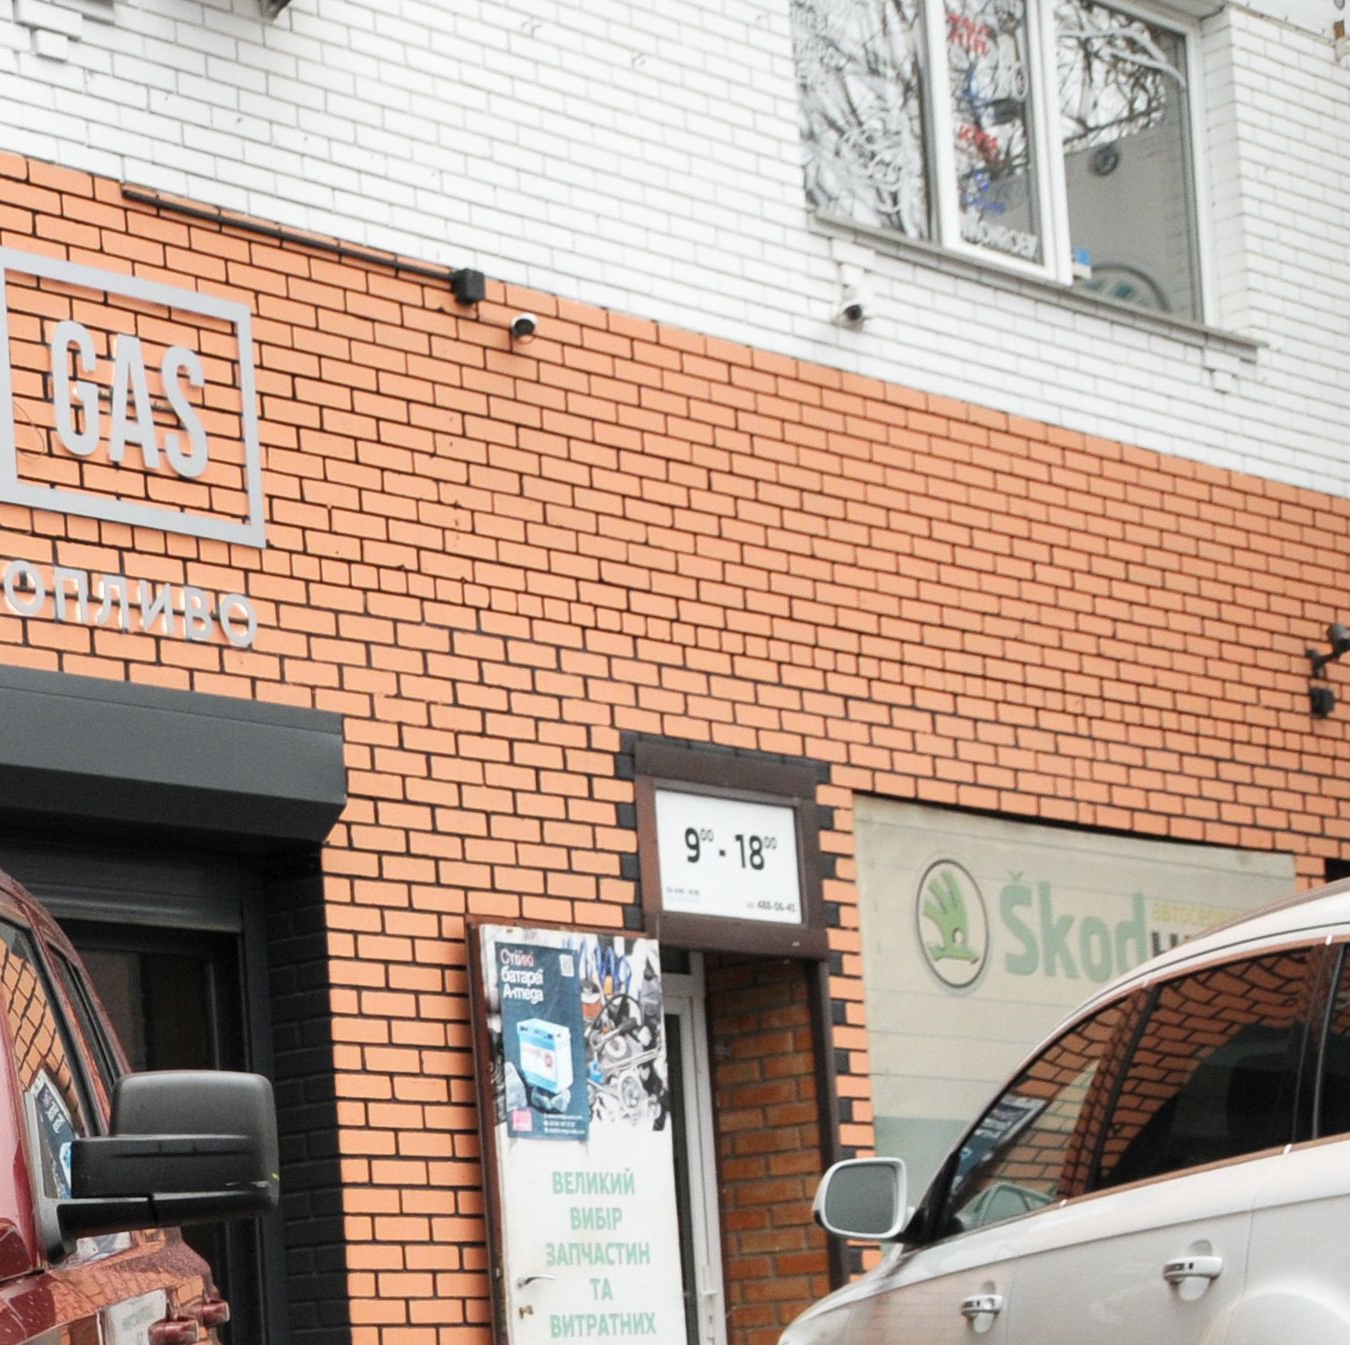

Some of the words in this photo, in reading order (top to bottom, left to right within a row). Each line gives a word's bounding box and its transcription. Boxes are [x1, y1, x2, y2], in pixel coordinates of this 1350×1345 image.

[50, 319, 210, 480] GAS
[552, 1167, 635, 1195] ВЕЛИКИЙ
[569, 1207, 623, 1230] ВИБІР
[546, 1242, 650, 1266] ЗАПЧАСТИН
[589, 1278, 613, 1301] ТА
[549, 1312, 657, 1338] ВИТРАТНИХ
